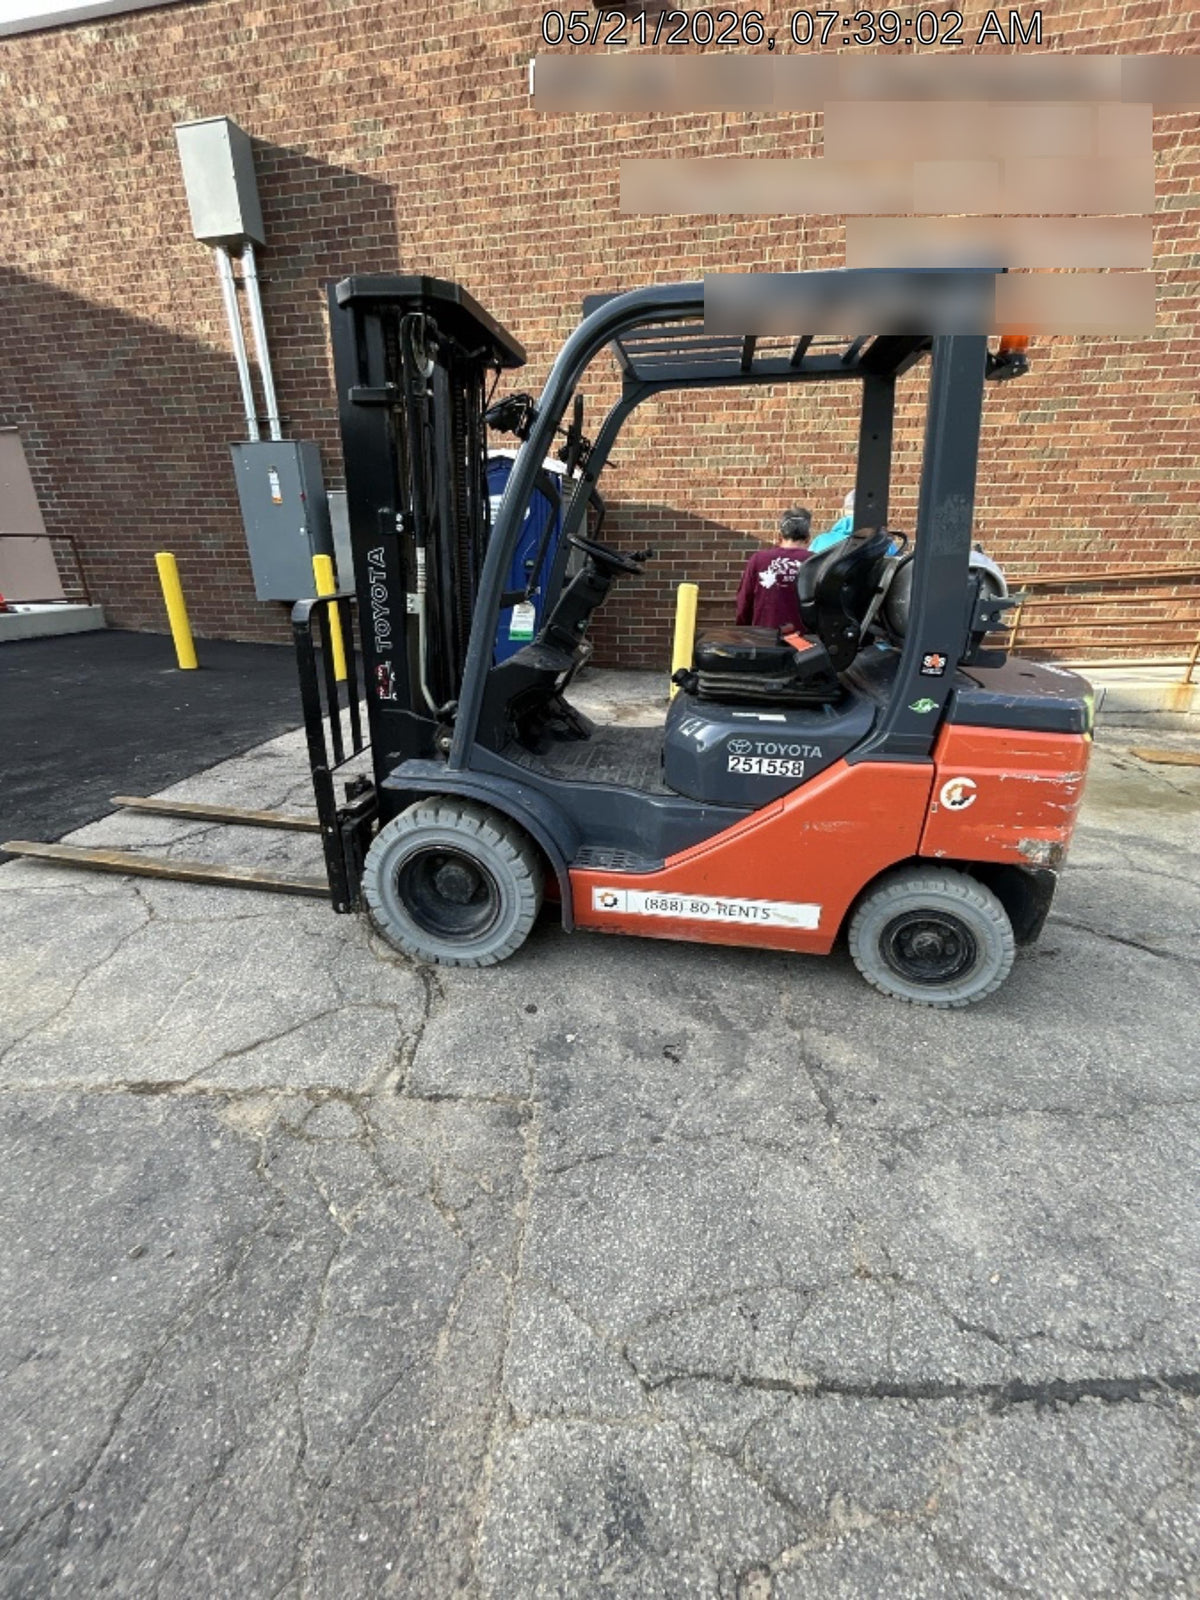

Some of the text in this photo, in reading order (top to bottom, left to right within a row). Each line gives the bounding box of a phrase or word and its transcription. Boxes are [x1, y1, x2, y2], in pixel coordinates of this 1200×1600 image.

[367, 547, 393, 653] TOYOTA
[755, 742, 822, 758] TOYOTA
[729, 756, 803, 776] 251558
[644, 897, 771, 920] (888) 80-RENTS
